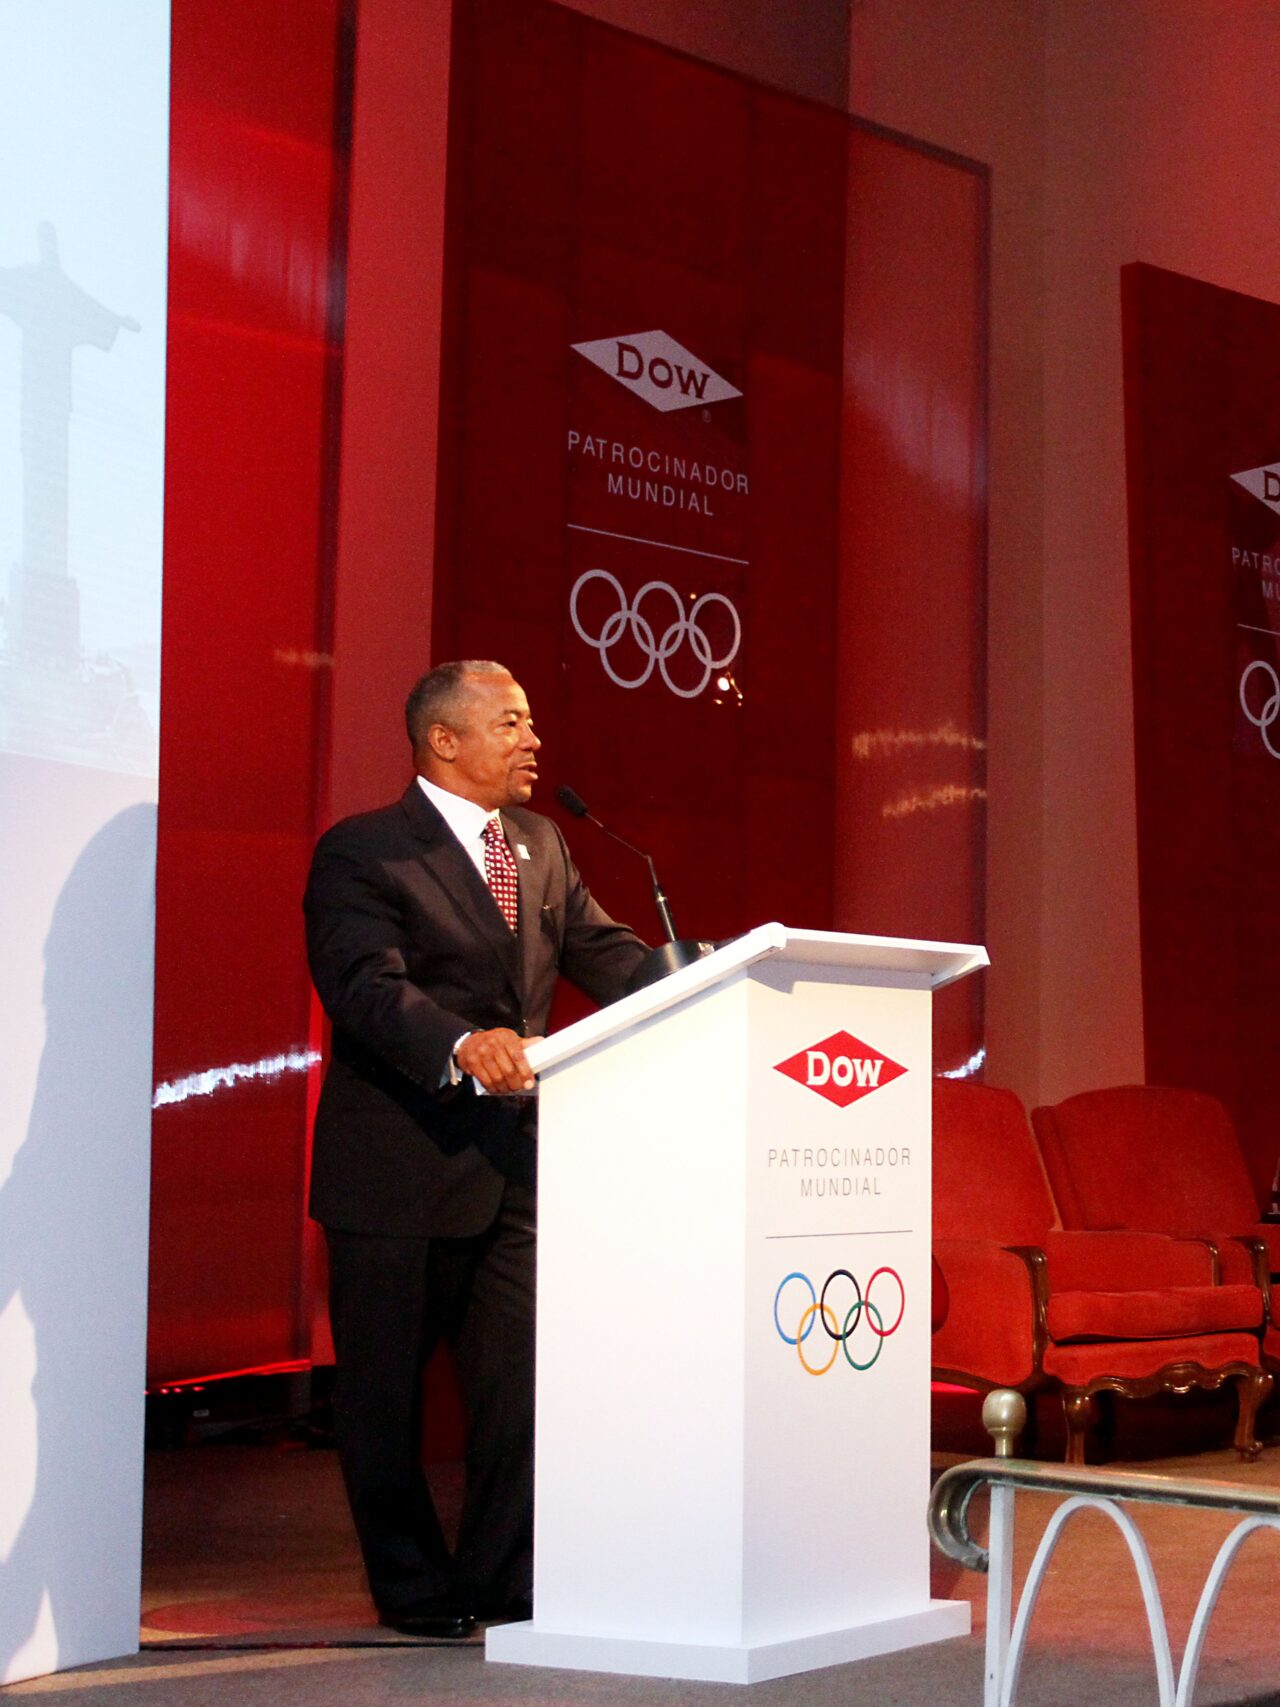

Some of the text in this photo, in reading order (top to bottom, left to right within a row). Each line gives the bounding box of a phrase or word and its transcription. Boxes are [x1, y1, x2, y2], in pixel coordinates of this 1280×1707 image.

[568, 430, 749, 495] PATROCINADOR
[607, 473, 714, 516] MUNDIAL
[768, 1147, 911, 1167] PATROCINADOR
[801, 1177, 881, 1197] MUNDIAL
